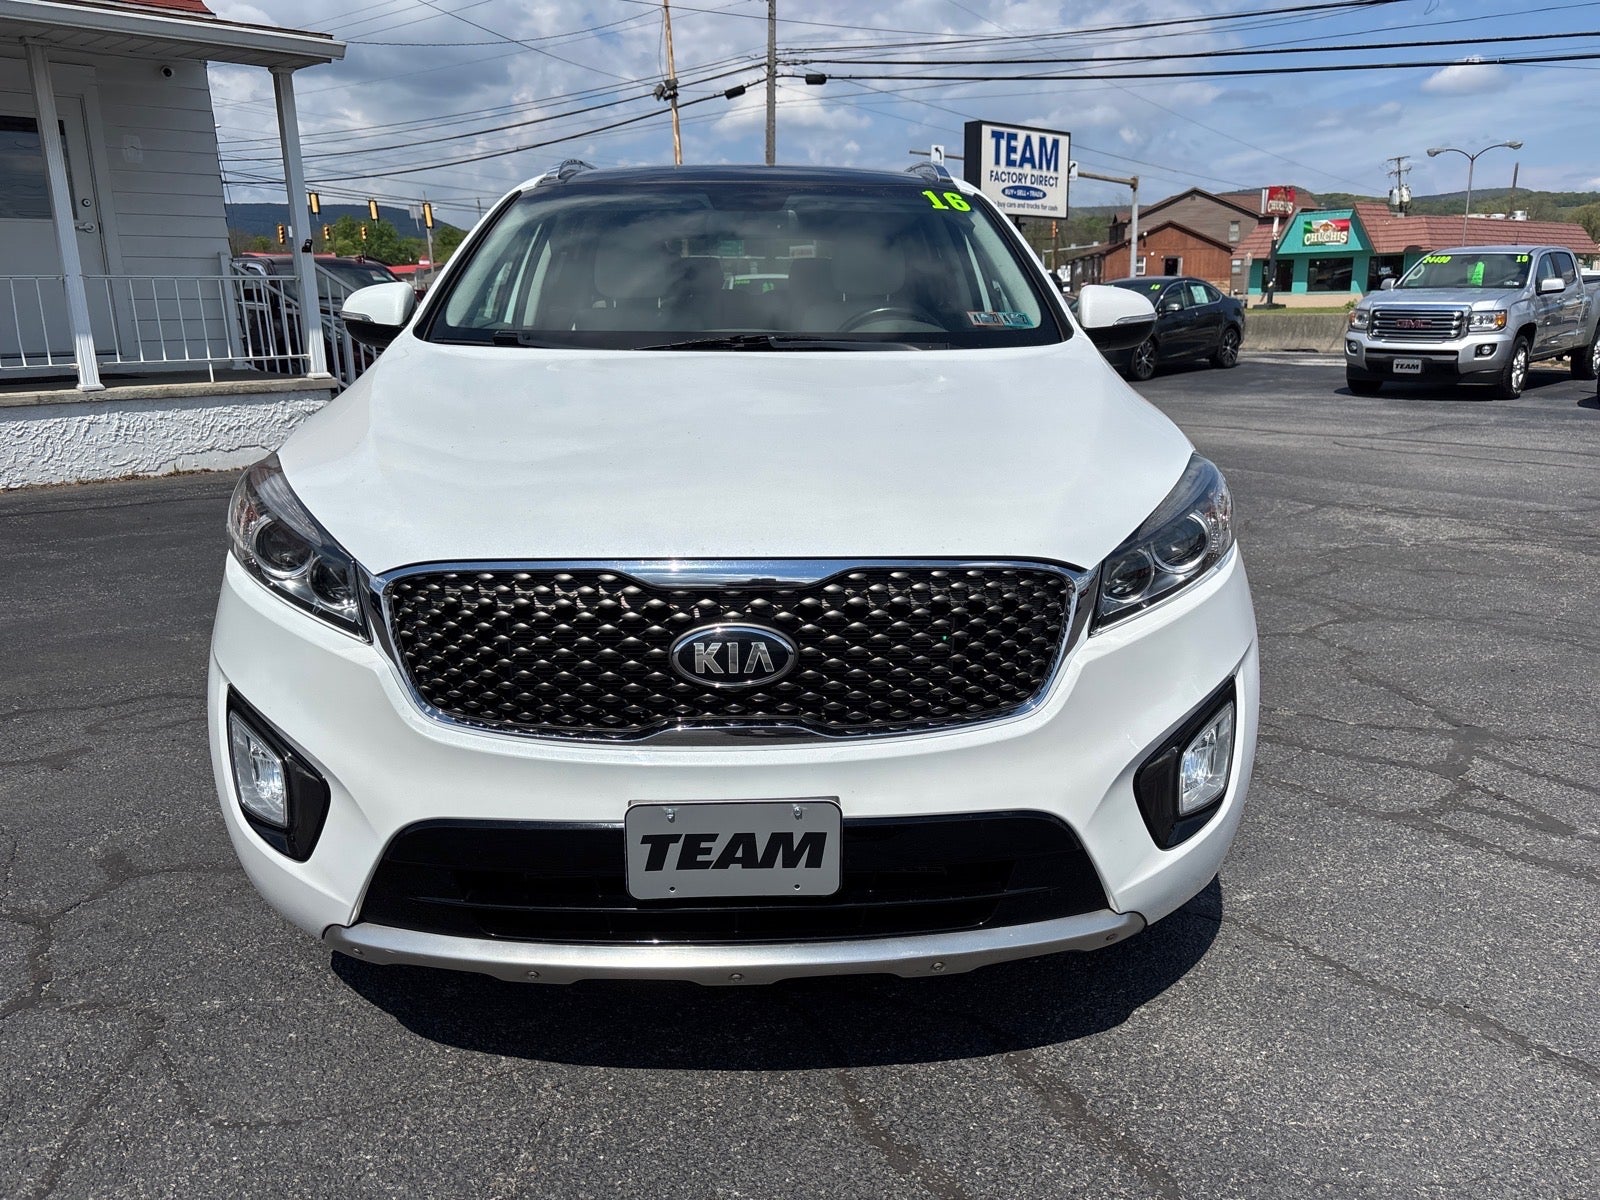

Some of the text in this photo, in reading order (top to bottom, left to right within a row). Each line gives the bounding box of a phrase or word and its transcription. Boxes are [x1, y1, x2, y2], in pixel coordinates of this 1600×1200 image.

[991, 130, 1059, 172] TEAM
[990, 170, 1059, 187] FACTORY DIRECT
[921, 190, 971, 212] 16
[1304, 231, 1348, 245] CHUCHIS
[1395, 319, 1432, 329] GMC
[693, 641, 775, 674] KIA
[640, 831, 828, 872] TEAM
